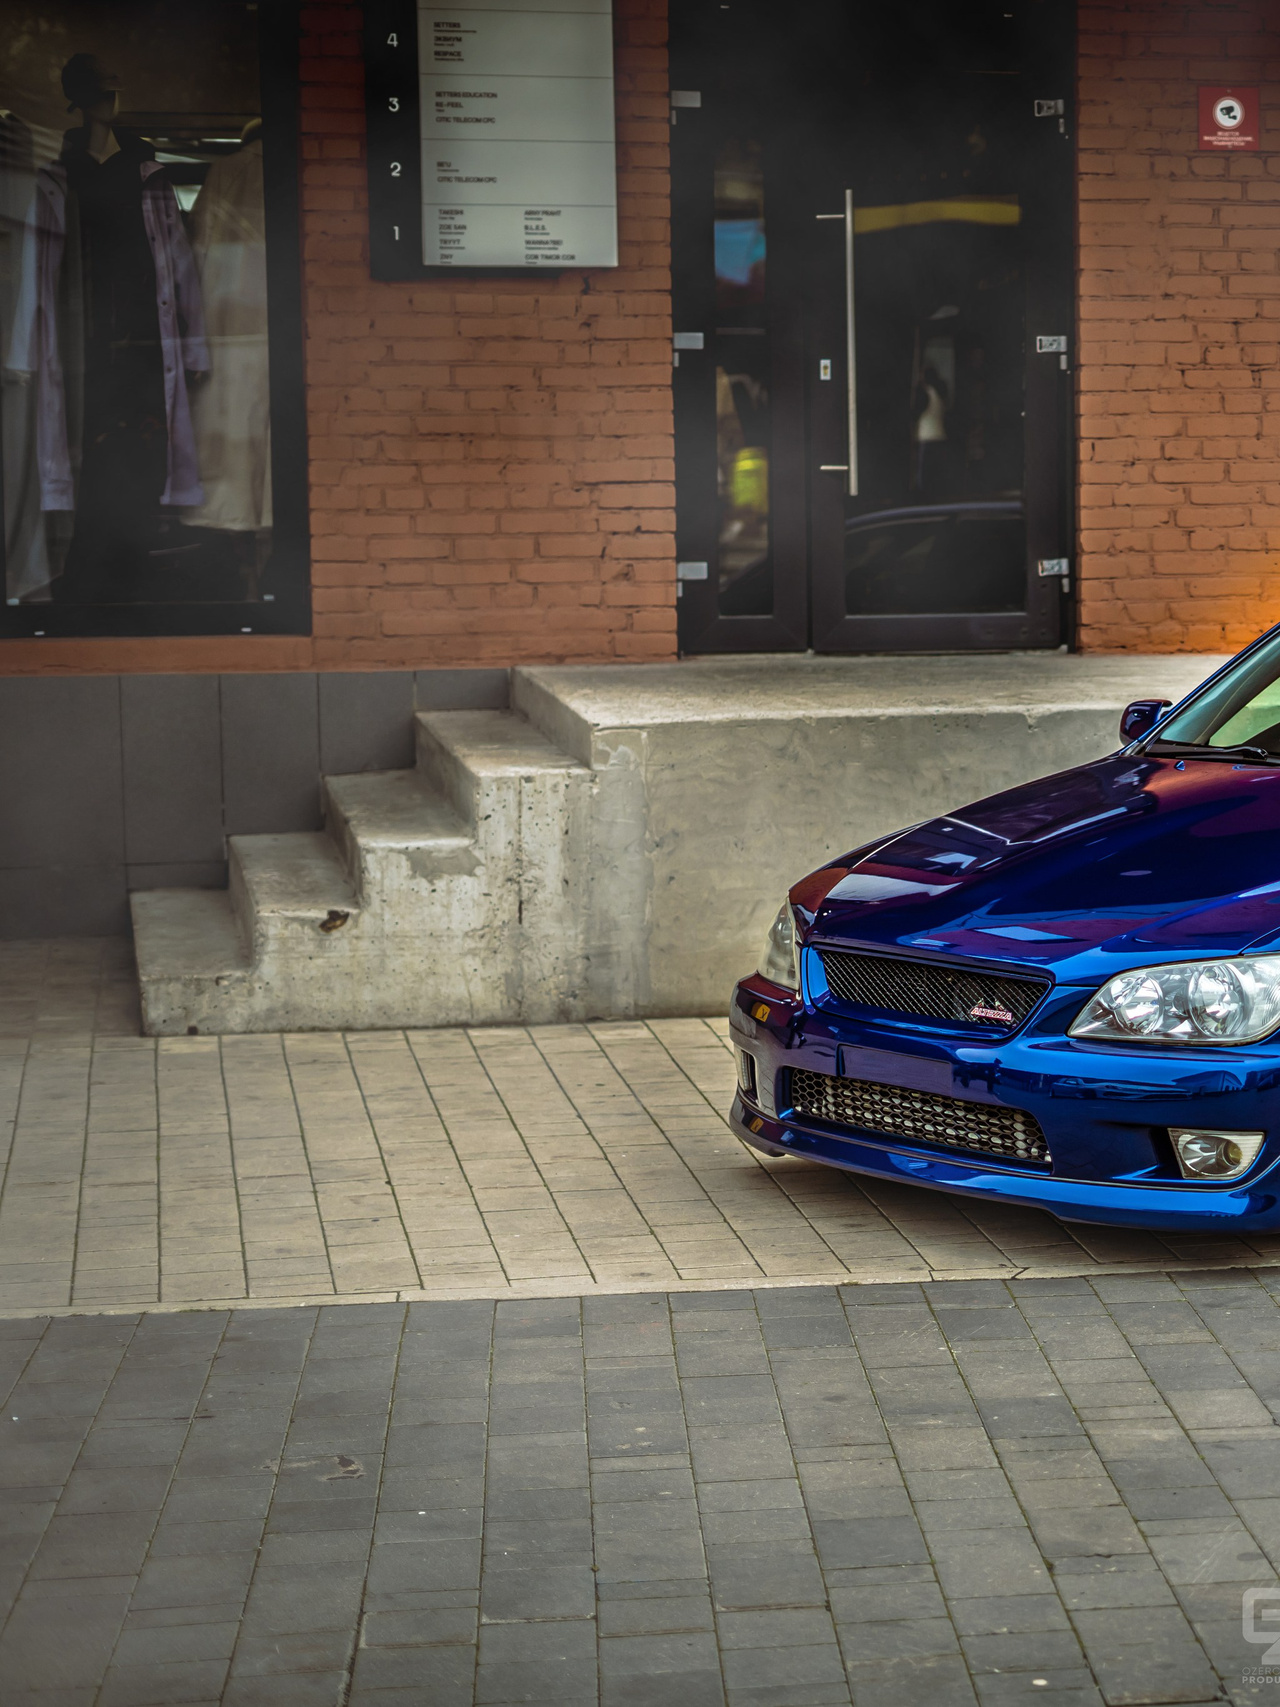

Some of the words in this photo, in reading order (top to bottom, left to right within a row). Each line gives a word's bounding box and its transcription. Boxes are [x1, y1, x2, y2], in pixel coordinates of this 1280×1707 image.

[387, 33, 398, 47] 4
[388, 97, 400, 112] 3
[390, 162, 402, 177] 2
[393, 226, 399, 240] 1
[970, 1007, 1012, 1021] ALTEZZA
